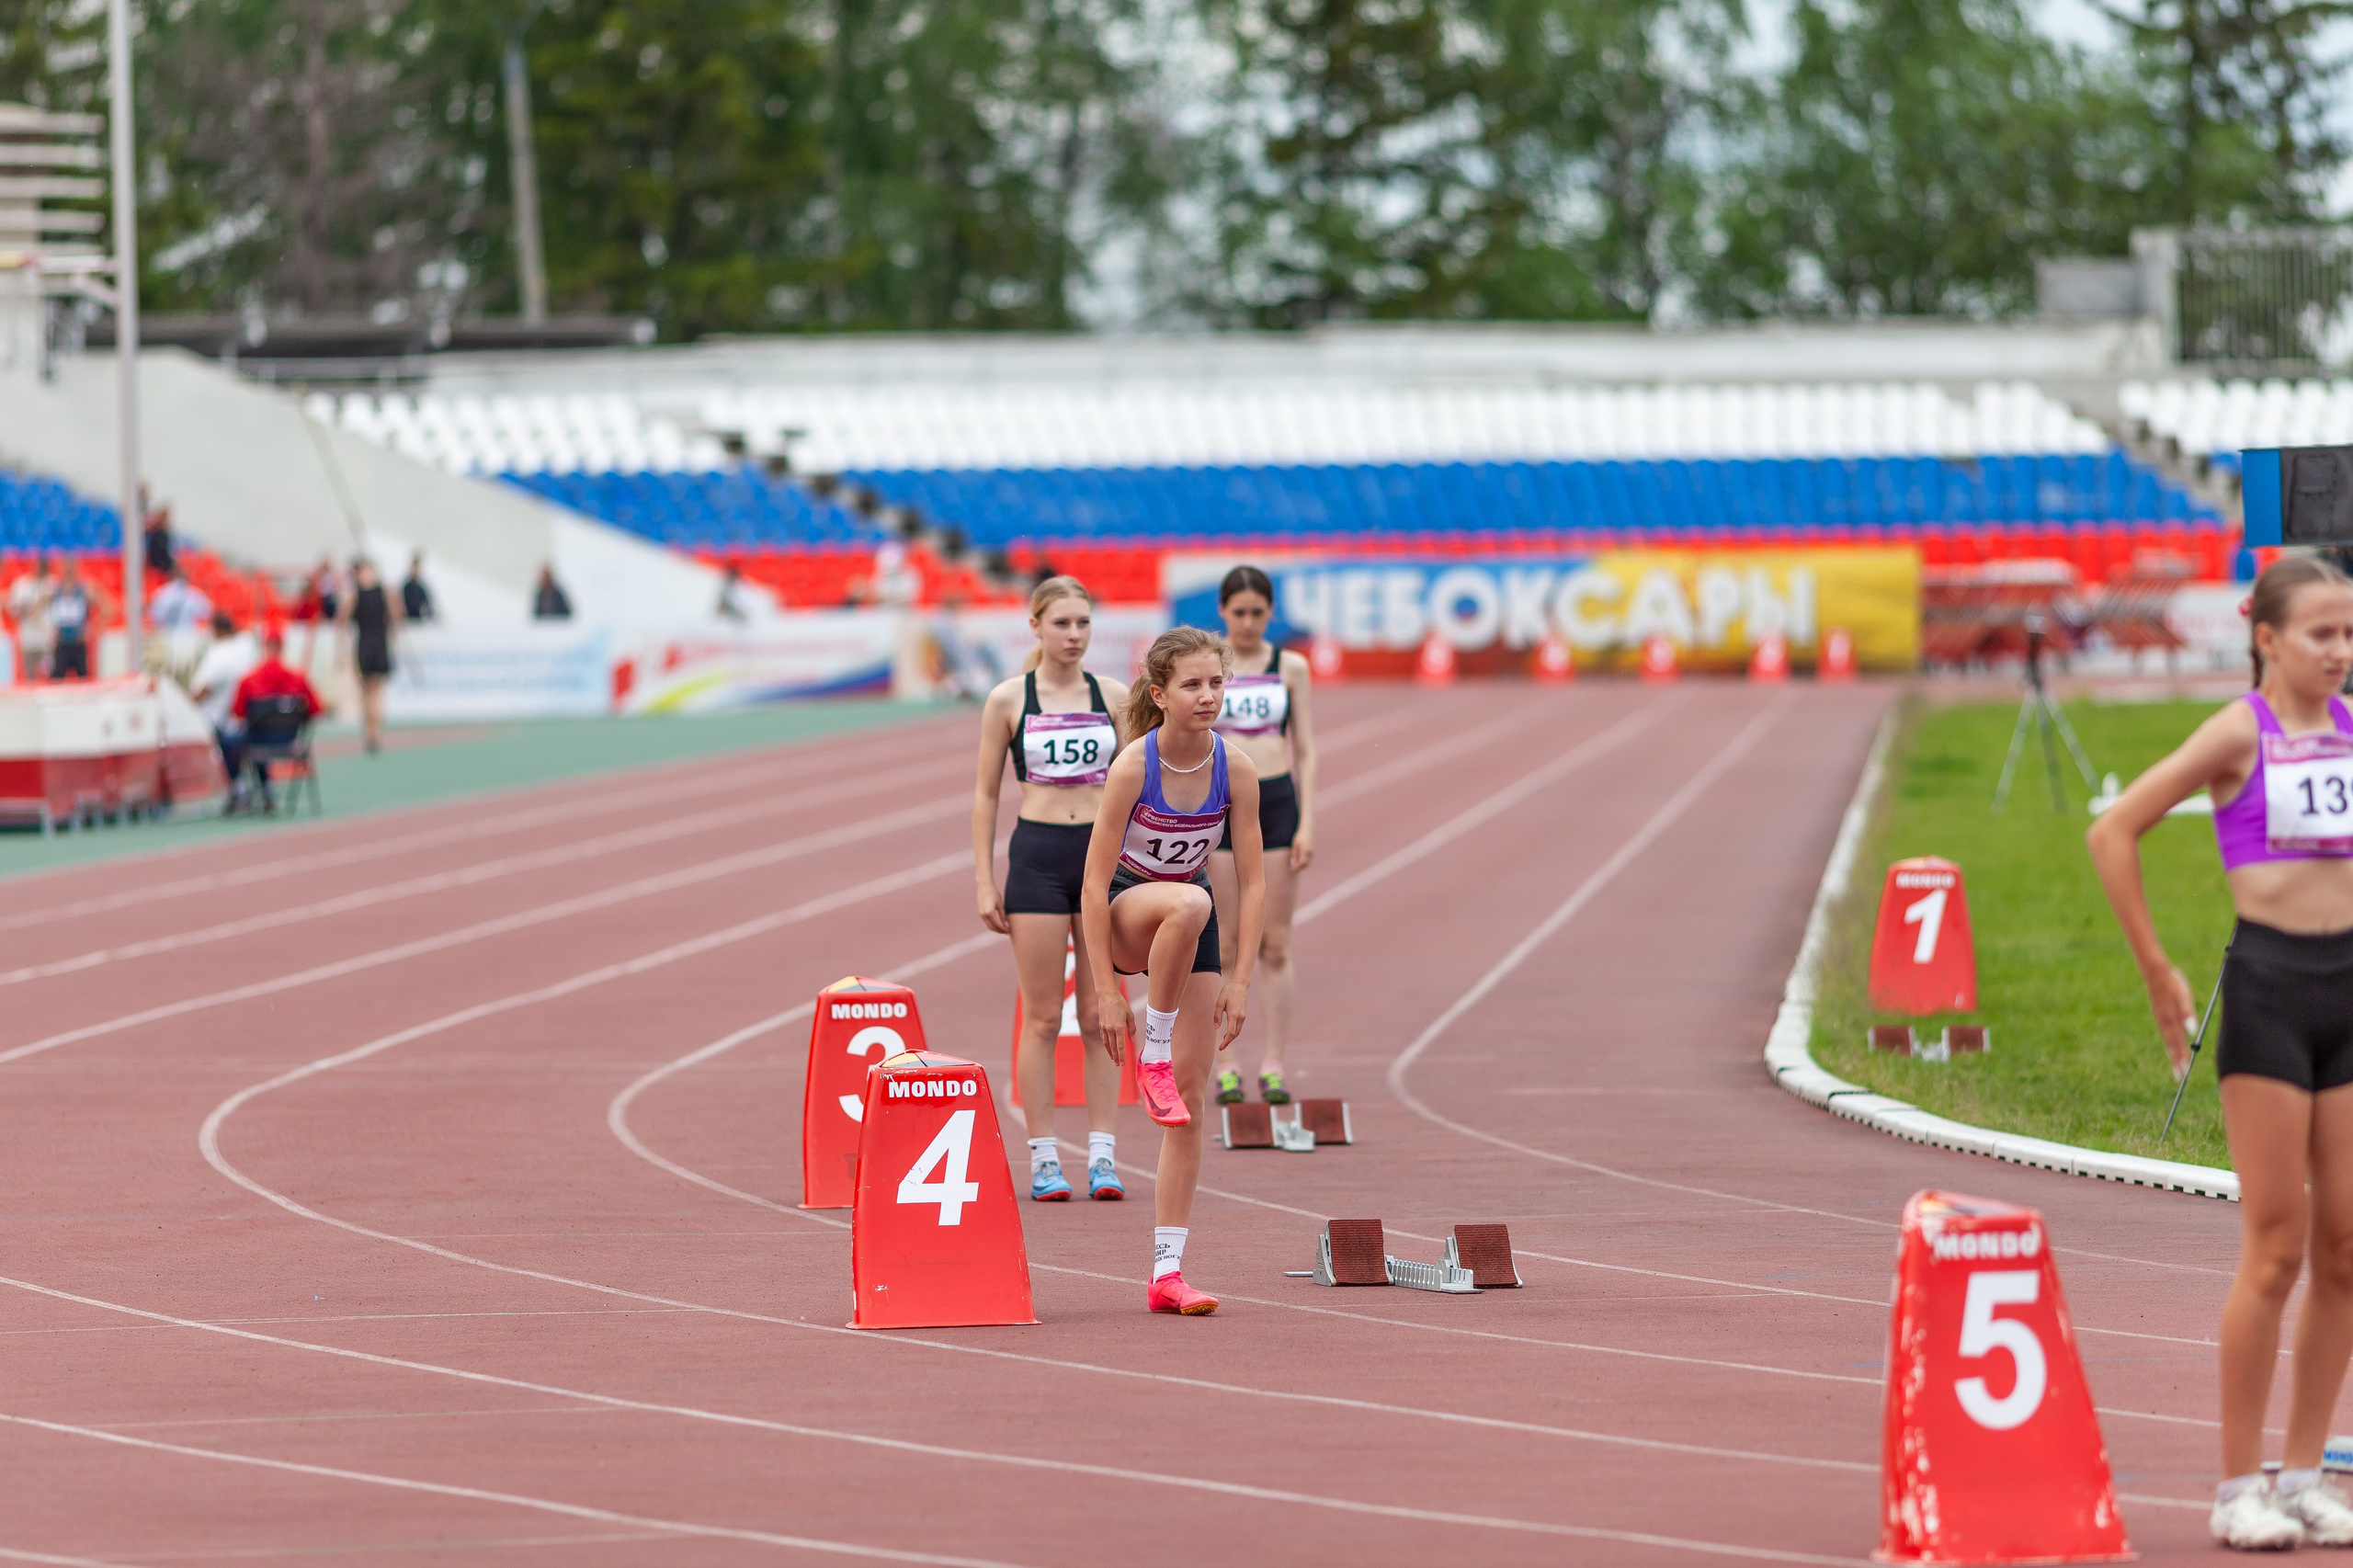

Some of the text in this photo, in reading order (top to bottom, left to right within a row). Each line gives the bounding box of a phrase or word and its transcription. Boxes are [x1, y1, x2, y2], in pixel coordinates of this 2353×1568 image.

[1289, 566, 1814, 649] ЧЕБОКСАРЫ
[1224, 696, 1270, 718] 148
[1043, 739, 1098, 765] 158
[2299, 776, 2353, 815] 13
[1146, 837, 1211, 865] 122
[1903, 888, 1948, 964] 1
[831, 1002, 907, 1019] MONDO
[838, 1026, 906, 1123] 3
[888, 1080, 977, 1098] MONDO
[896, 1109, 980, 1226] 4
[1933, 1232, 2040, 1258] MONDO
[1954, 1270, 2047, 1430] 5
